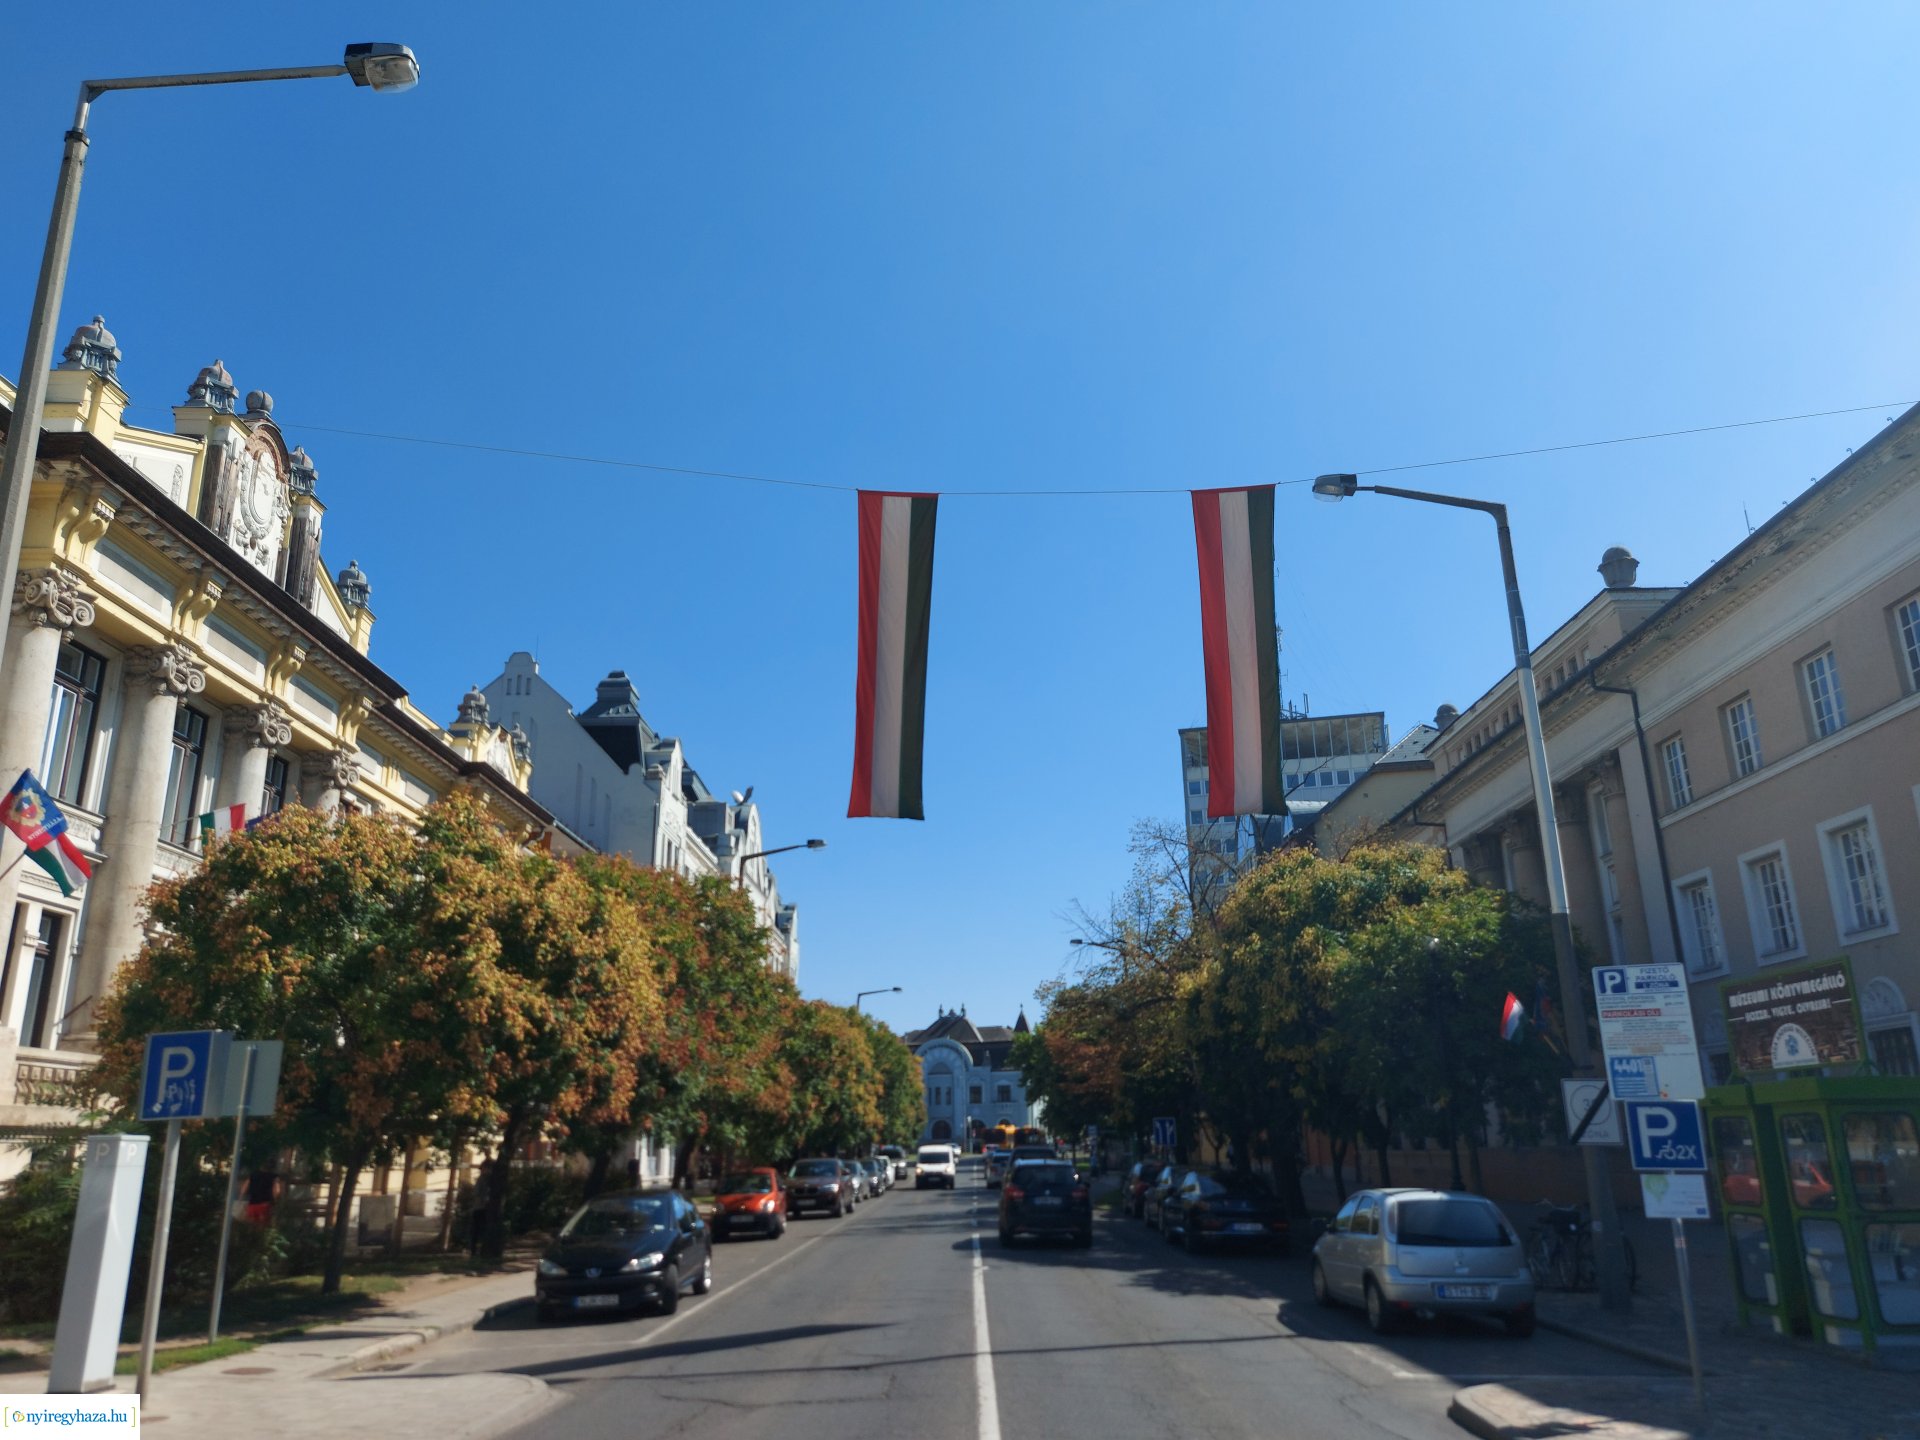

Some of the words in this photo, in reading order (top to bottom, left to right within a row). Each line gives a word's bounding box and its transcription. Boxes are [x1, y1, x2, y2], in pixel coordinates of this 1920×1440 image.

[1603, 971, 1622, 994] P
[1729, 988, 1769, 1008] MÚZEUMI
[1770, 970, 1846, 1000] KÖNYVMEGÁLLÓ
[158, 1046, 196, 1103] P
[1614, 1058, 1642, 1073] 4401
[1636, 1106, 1677, 1158] P
[1677, 1145, 1697, 1160] 2X
